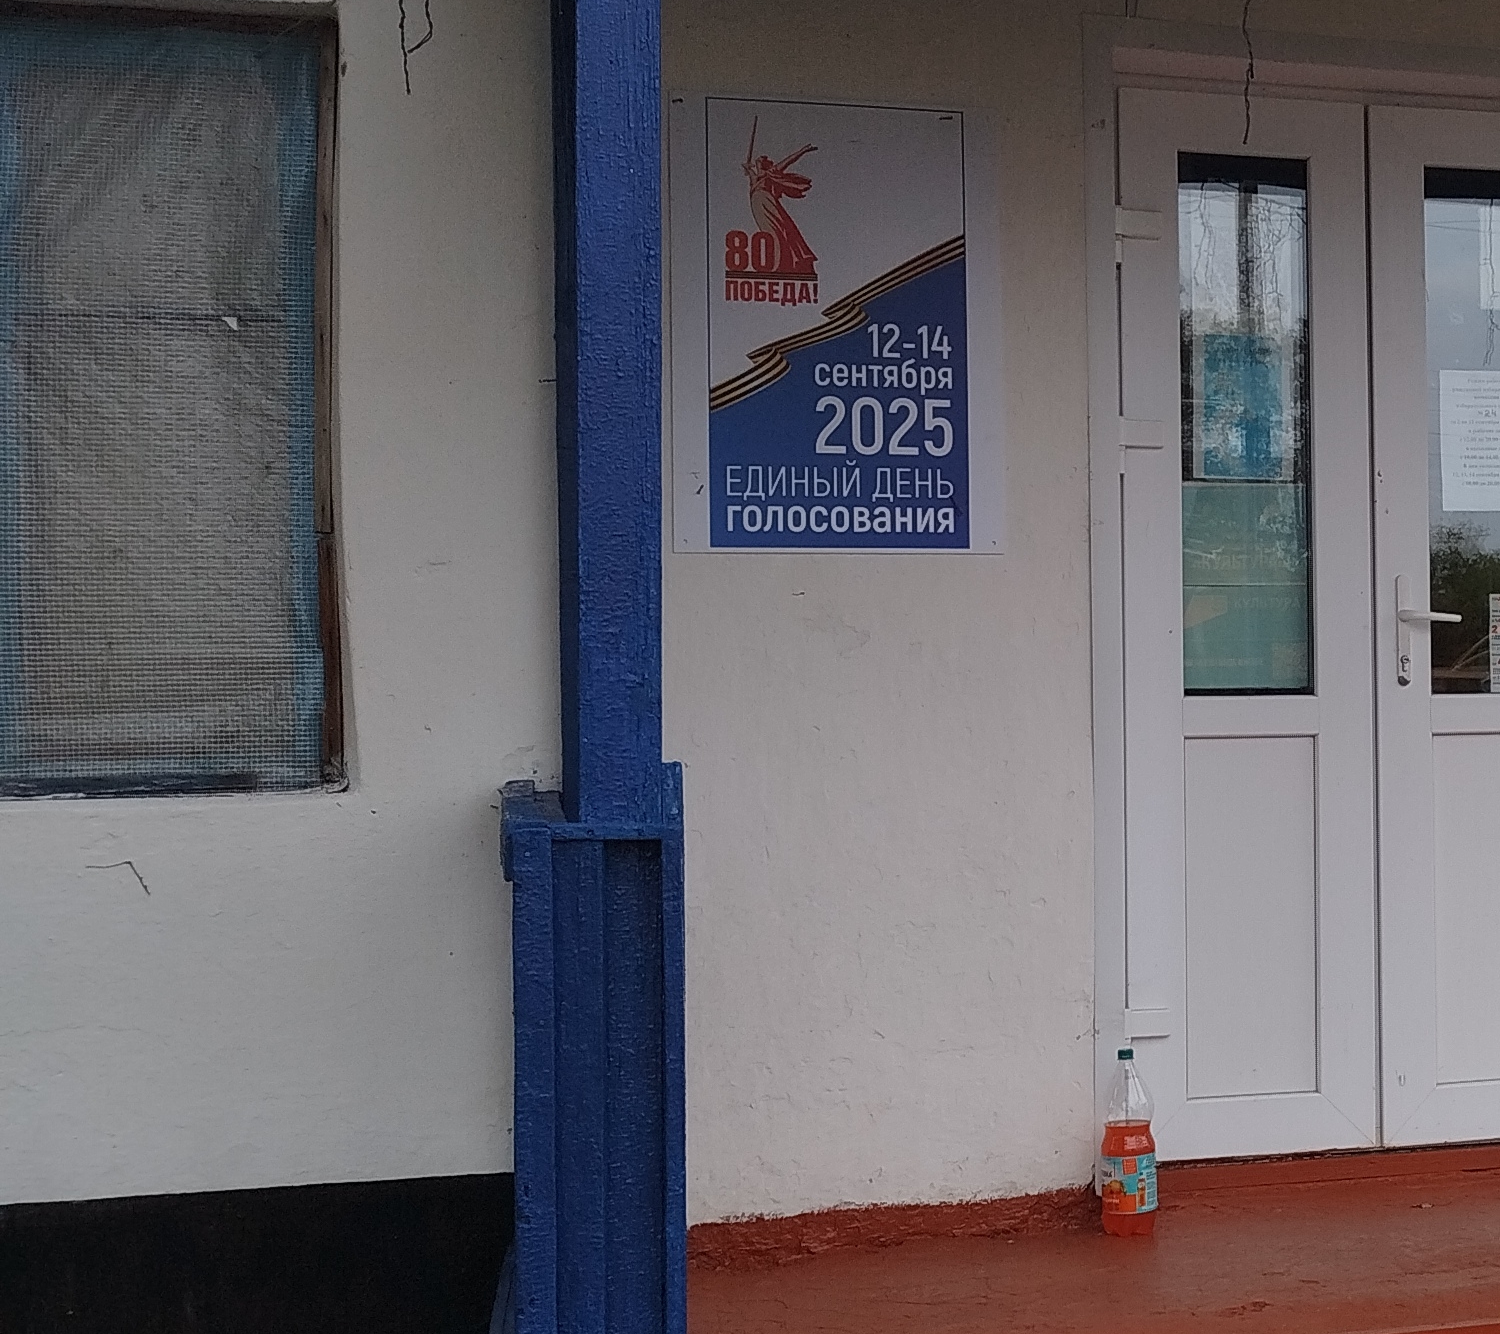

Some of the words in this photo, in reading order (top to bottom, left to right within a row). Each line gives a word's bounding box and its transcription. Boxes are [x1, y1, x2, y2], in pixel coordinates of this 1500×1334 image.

[725, 230, 774, 272] 80
[725, 280, 819, 306] ПОБЕДА!
[867, 323, 953, 360] 12-14
[814, 358, 953, 395] сентября
[815, 396, 954, 457] 2025
[725, 460, 862, 502] ЕДИНЫЙ
[872, 467, 954, 502] ДЕНЬ
